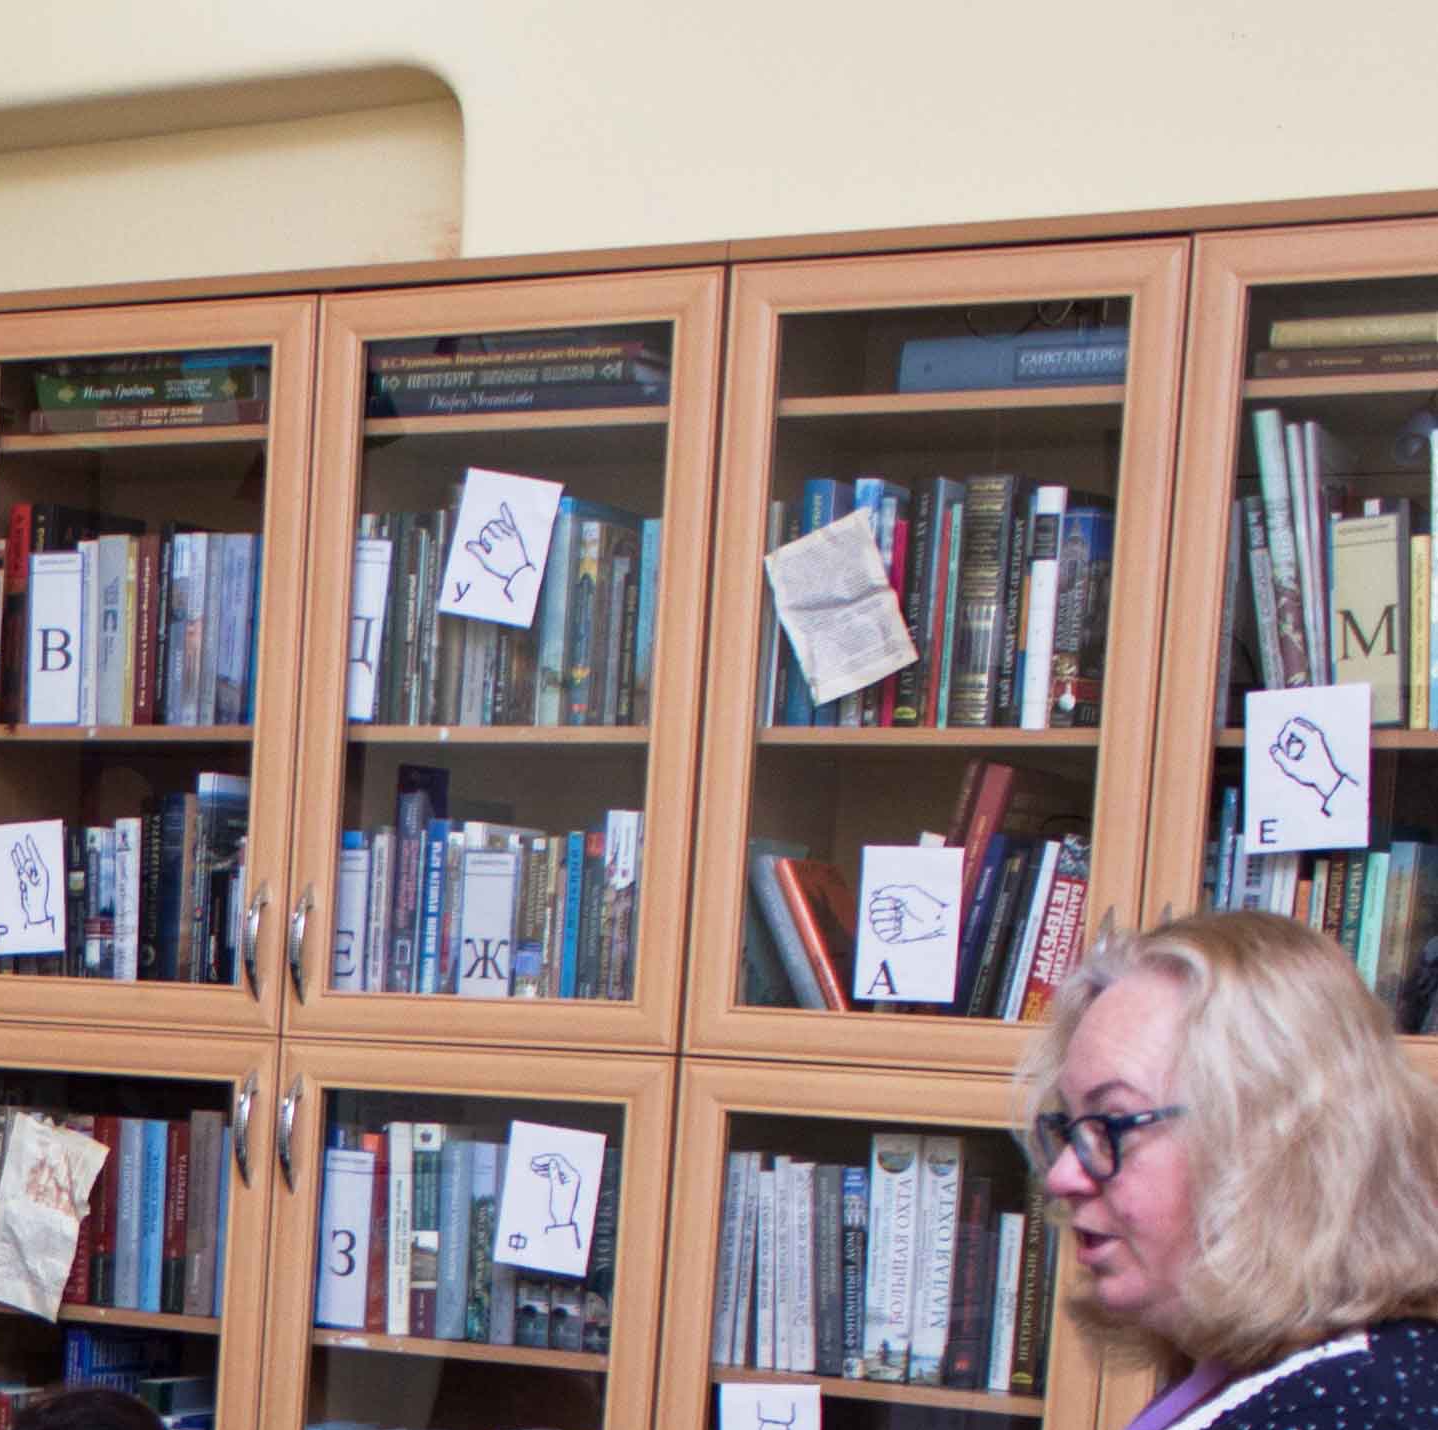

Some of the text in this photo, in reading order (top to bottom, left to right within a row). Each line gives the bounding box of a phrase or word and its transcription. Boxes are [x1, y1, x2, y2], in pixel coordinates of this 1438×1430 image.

[453, 583, 470, 602] У
[37, 629, 72, 672] В
[1337, 604, 1398, 661] М
[1260, 818, 1278, 844] Е
[1026, 878, 1071, 983] ПЕТЕРБУРГ
[464, 938, 508, 978] Ж
[867, 961, 896, 995] А
[1026, 1193, 1045, 1244] ХРАМЫ
[888, 1176, 913, 1326] БОЛЬШАЯ ОХТА
[928, 1180, 957, 1329] МАЛАЯ ОХТА
